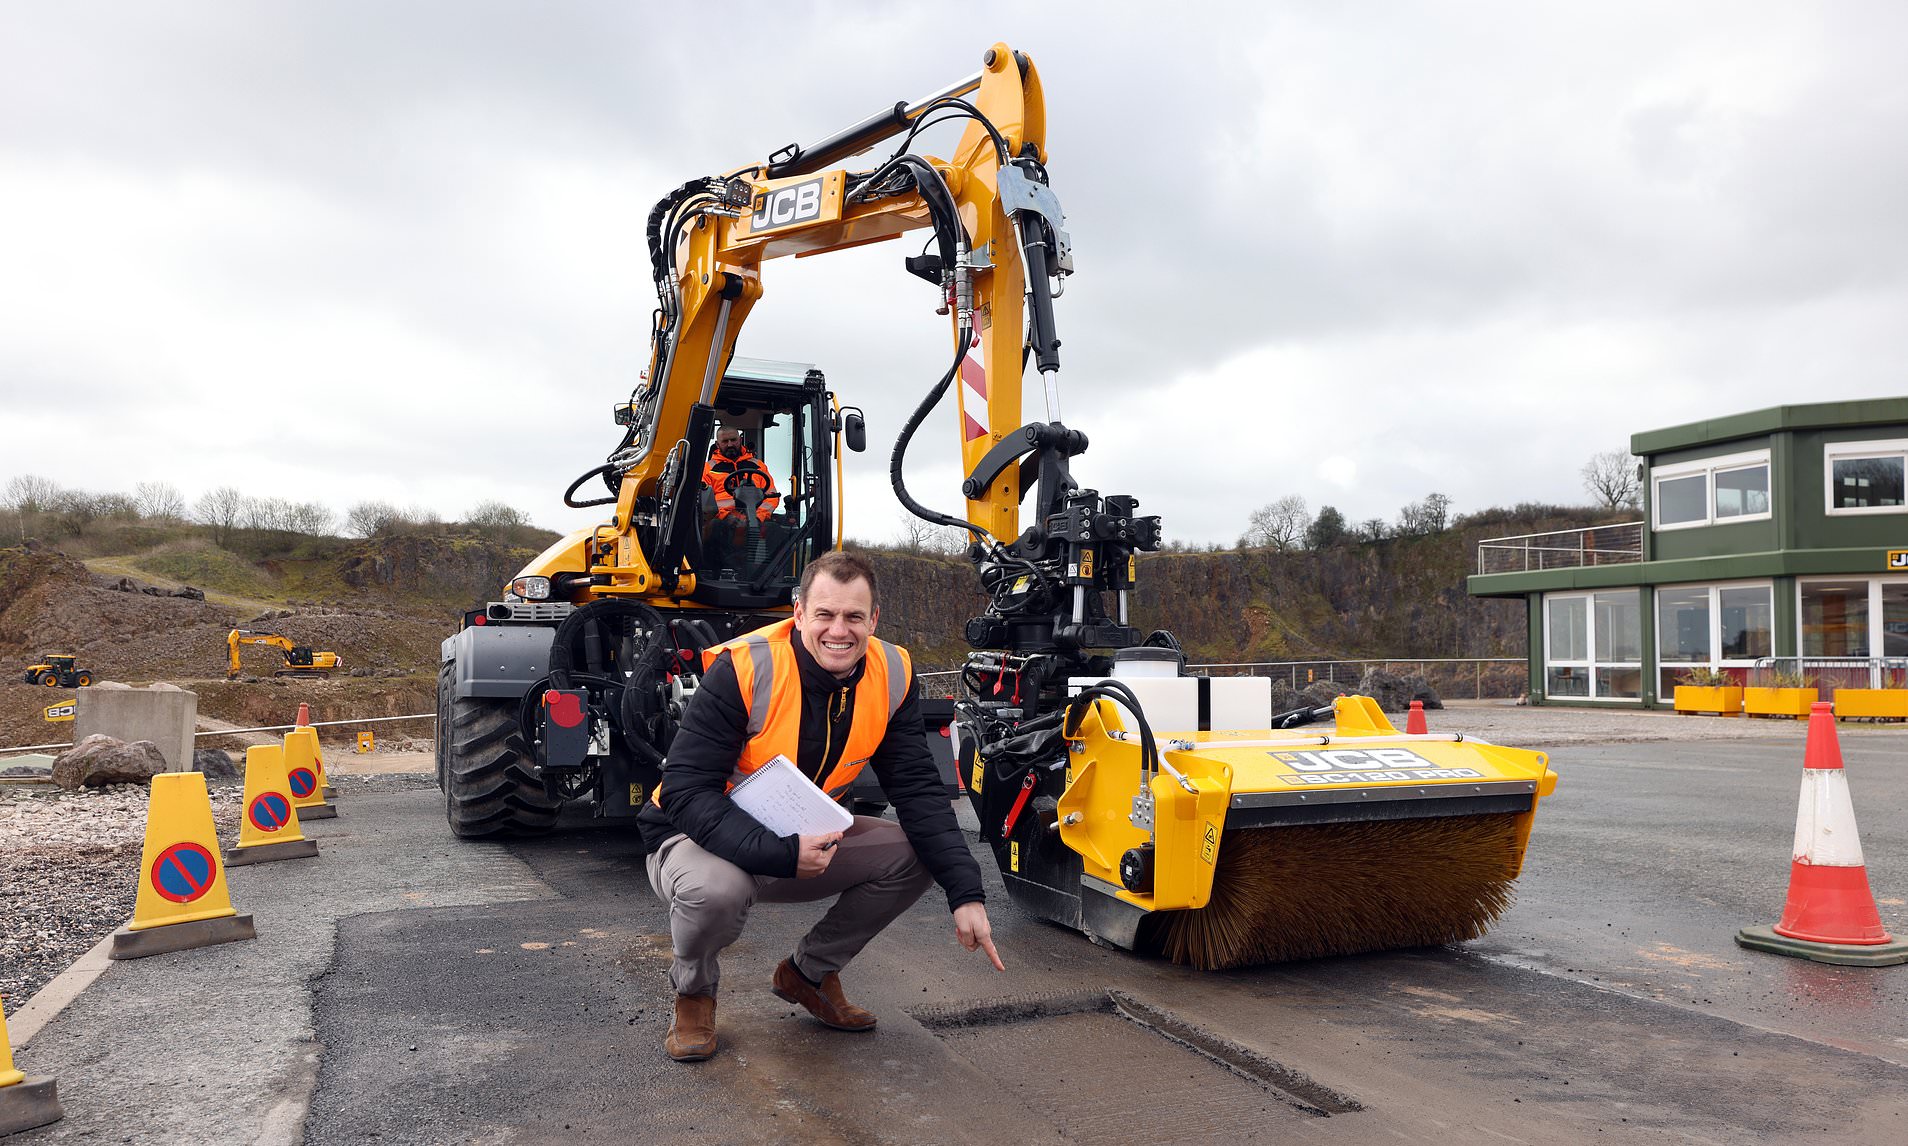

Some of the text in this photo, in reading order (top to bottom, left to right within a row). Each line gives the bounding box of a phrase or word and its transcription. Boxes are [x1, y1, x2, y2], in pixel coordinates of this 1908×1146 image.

[753, 182, 820, 229] JCB
[1288, 749, 1431, 772] JCB
[1300, 768, 1480, 785] SC120 PRO
